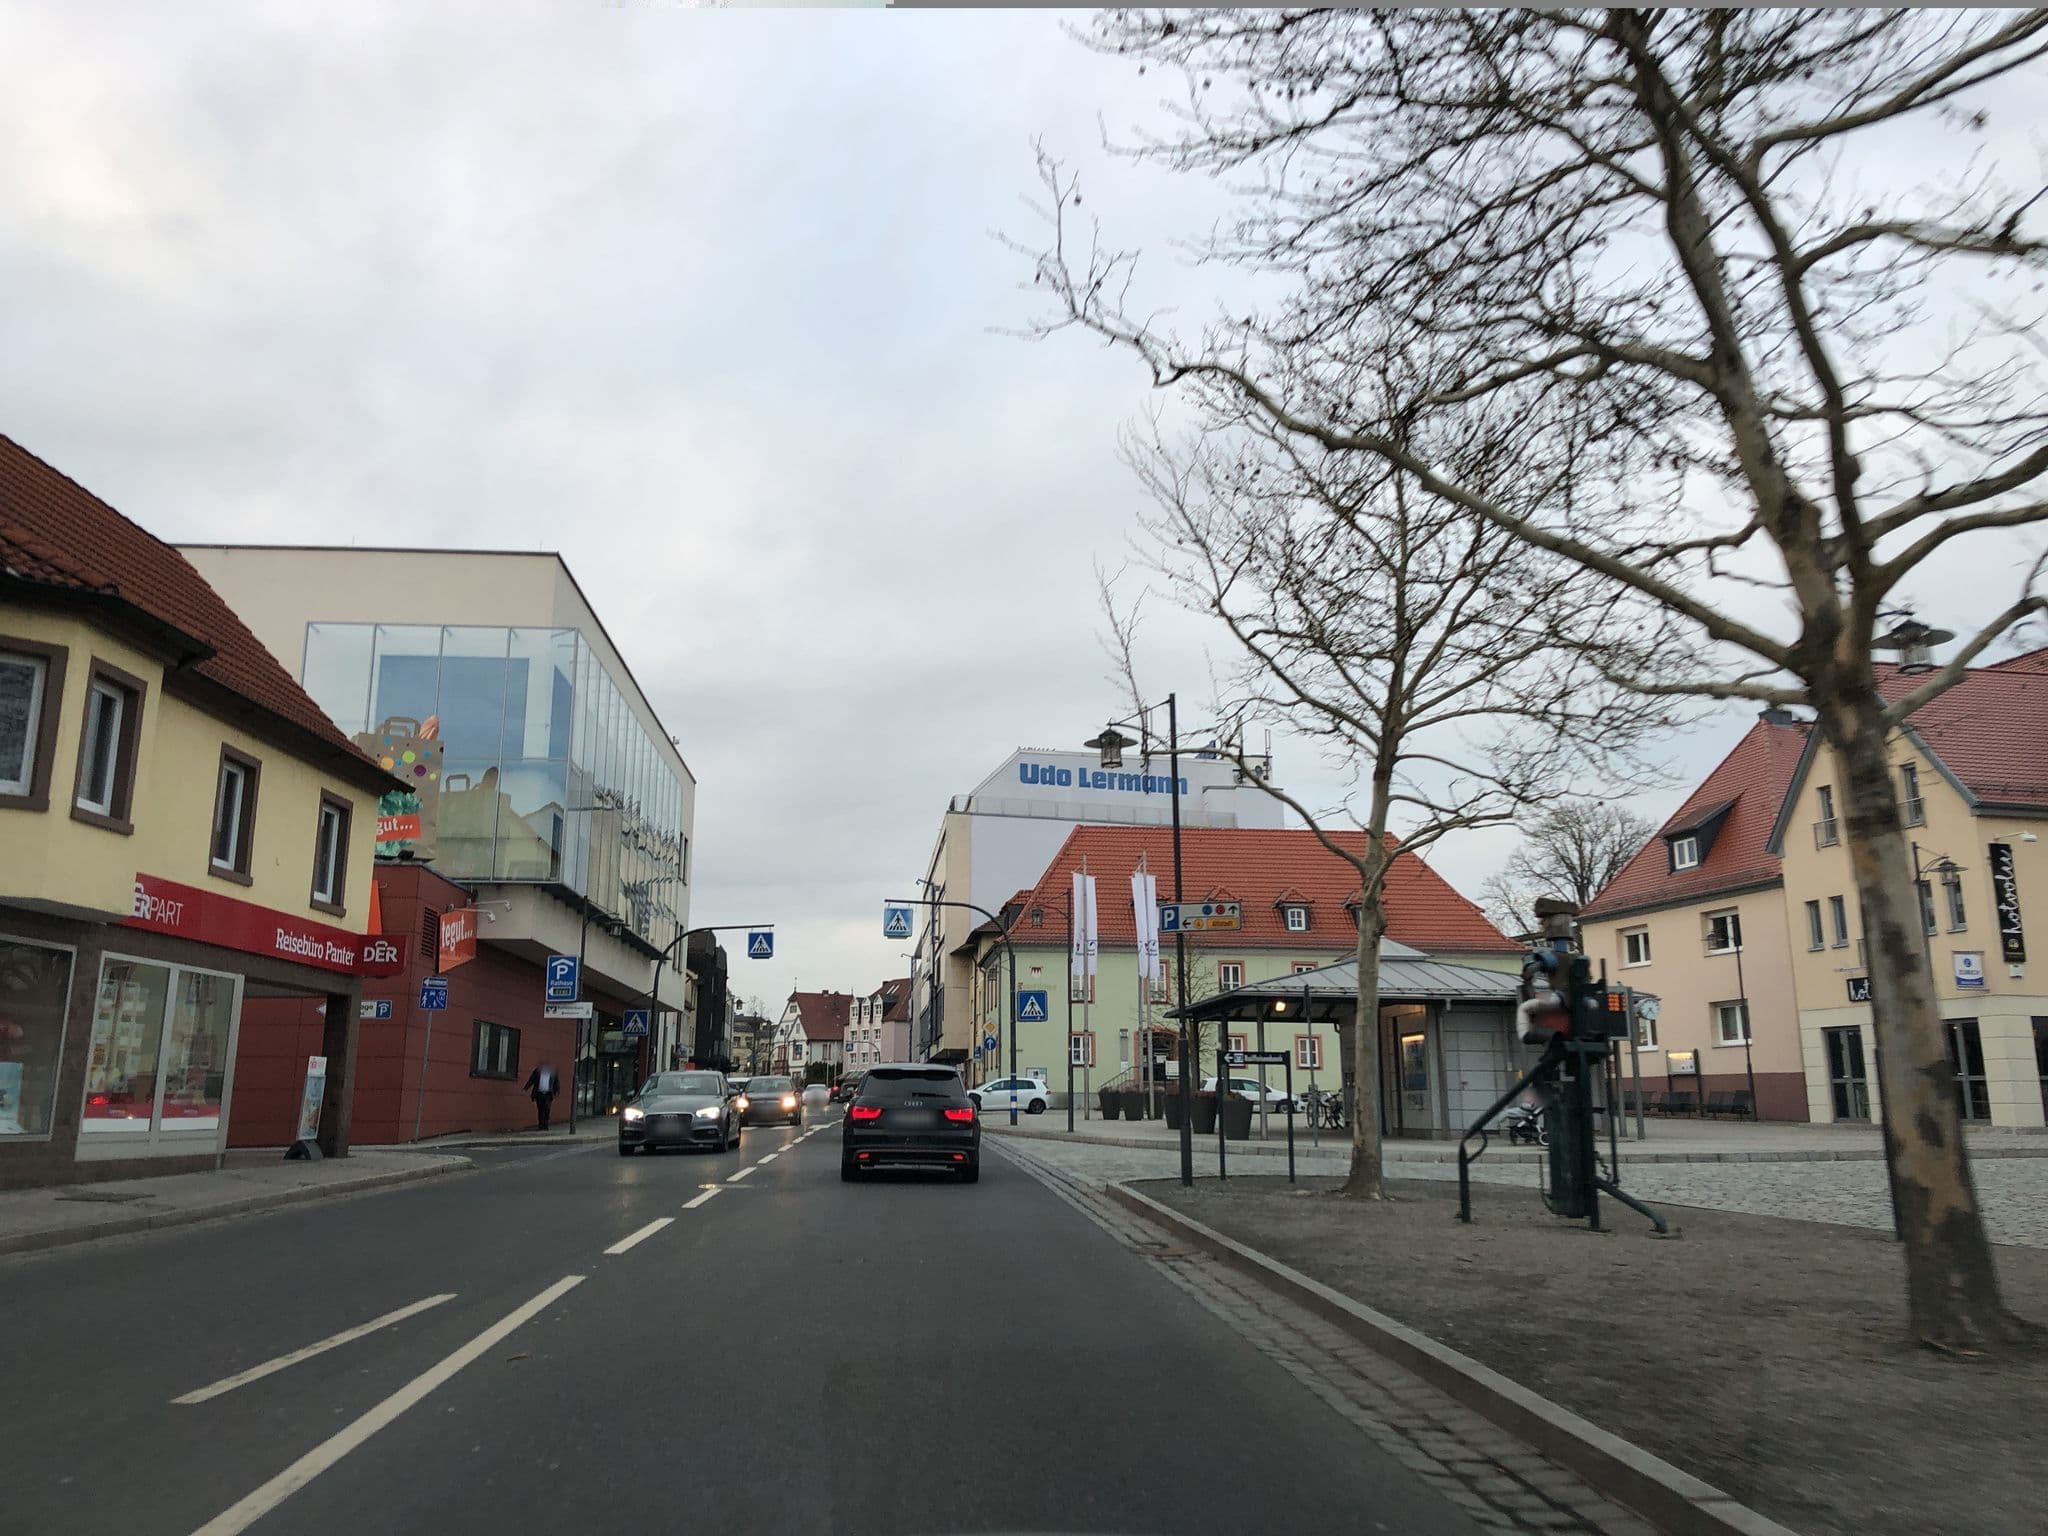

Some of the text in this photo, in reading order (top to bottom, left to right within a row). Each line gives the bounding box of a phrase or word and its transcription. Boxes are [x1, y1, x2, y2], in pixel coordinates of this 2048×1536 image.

[1019, 762, 1188, 794] Udo Lermann
[1163, 909, 1176, 929] P
[275, 928, 355, 967] Reisebüro Panter
[363, 942, 398, 963] DER
[556, 965, 569, 980] P
[380, 1006, 388, 1017] P
